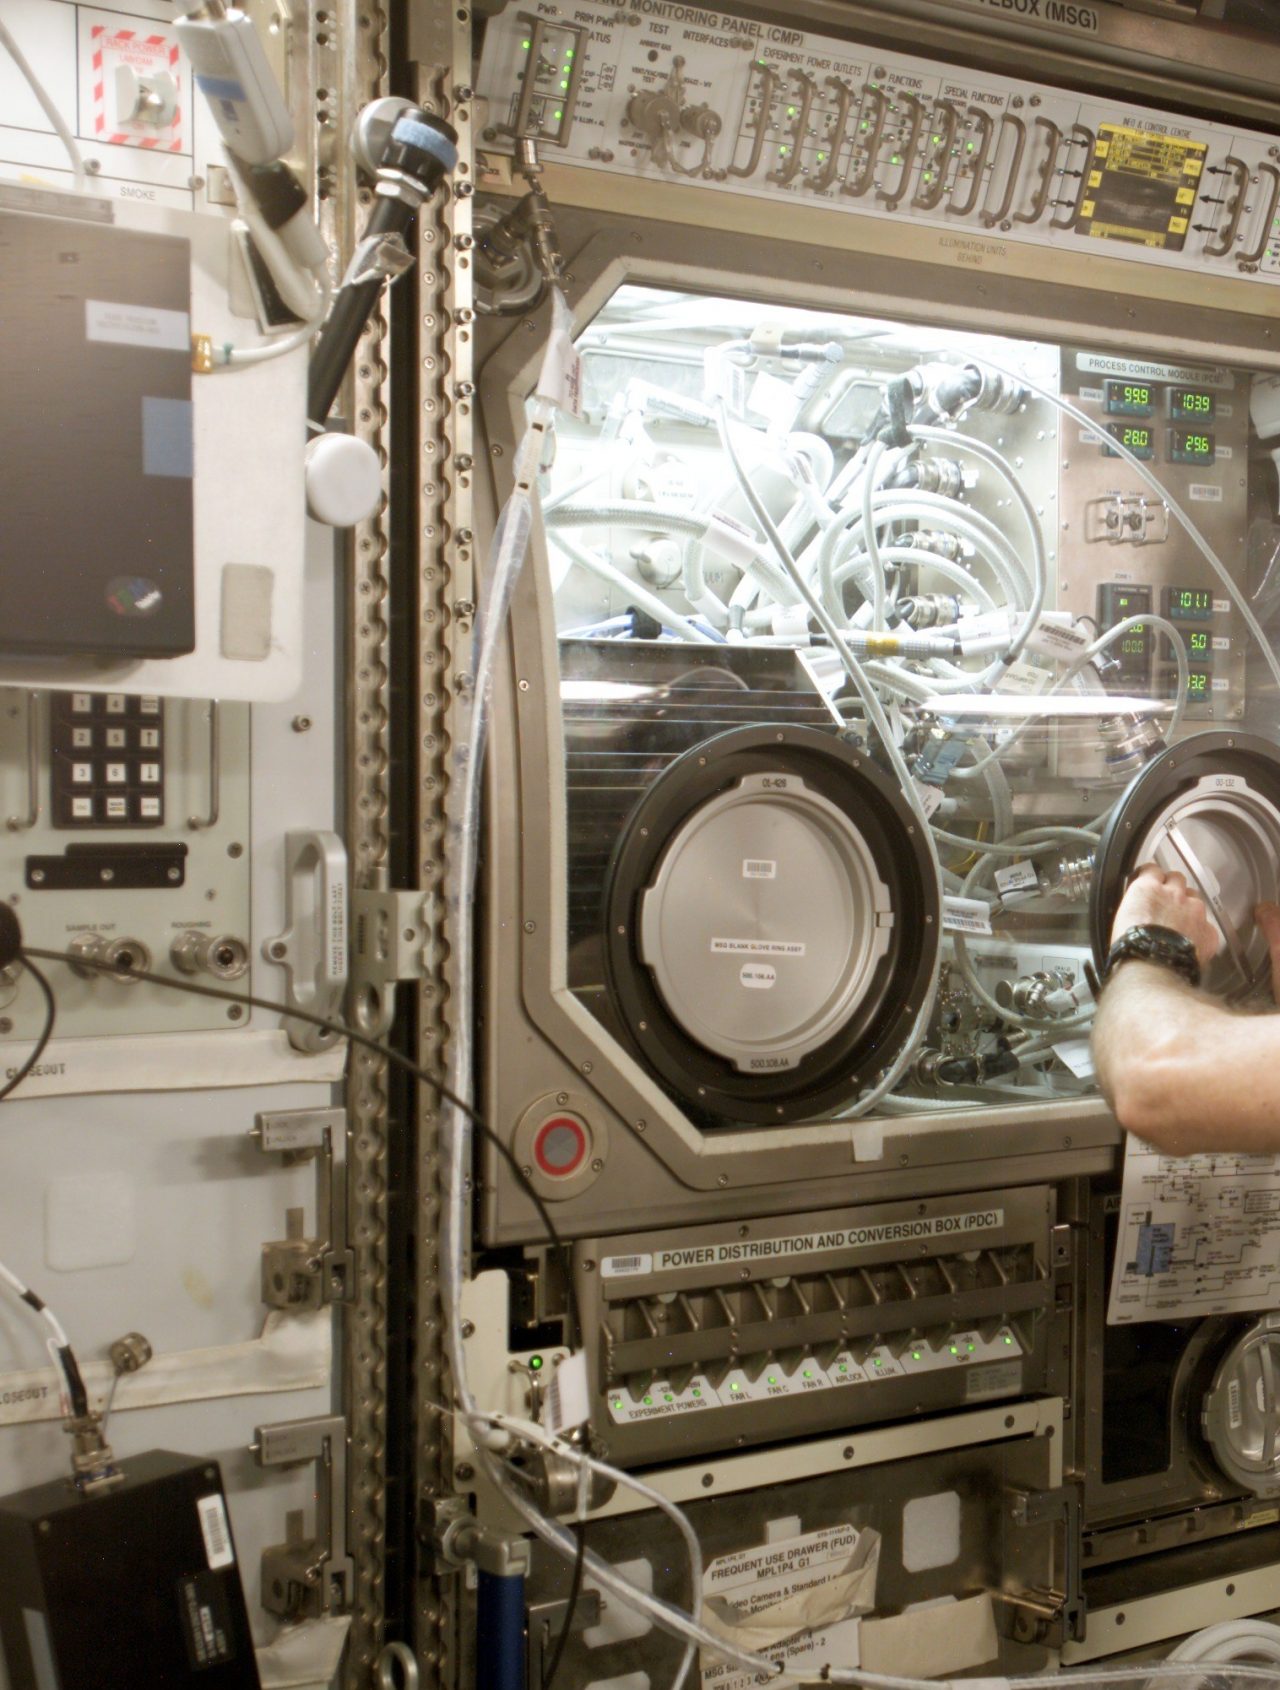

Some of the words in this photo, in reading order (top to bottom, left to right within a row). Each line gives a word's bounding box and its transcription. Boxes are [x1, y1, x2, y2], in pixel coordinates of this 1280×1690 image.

[537, 3, 558, 15] PWR
[982, 0, 1040, 16] BOX
[1045, 1, 1098, 31] (MSG)
[629, 0, 719, 28] MONITORING
[720, 14, 765, 39] PANEL
[766, 26, 804, 46] (CMP)
[648, 22, 670, 35] TEST
[682, 30, 729, 48] INTERFACES
[763, 47, 805, 64] EXPERIMENT
[806, 56, 832, 70] POWER
[833, 62, 863, 76] OUTLETS
[888, 74, 924, 88] FUNCTIONS
[944, 86, 969, 100] SPECIAL
[970, 90, 1005, 106] FUNCTIONS
[119, 185, 156, 201] SMOKE
[1089, 358, 1127, 372] PROCESS
[1128, 364, 1166, 377] CONTROL
[1167, 369, 1199, 381] MODULE
[79, 767, 86, 776] 3
[111, 768, 119, 777] 6
[65, 924, 98, 932] SAMPLE
[99, 923, 116, 931] OUT
[171, 921, 212, 929] ROUGHING
[661, 1248, 715, 1268] POWER
[718, 1236, 814, 1261] DISTRIBUTION
[816, 1233, 845, 1249] AND
[847, 1221, 932, 1245] CONVERSION
[935, 1216, 961, 1233] BOX
[963, 1212, 998, 1230] (PDC)
[802, 1380, 818, 1390] FAN
[818, 1379, 824, 1388] R
[835, 1373, 863, 1384] AIRLOCK
[729, 1392, 745, 1402] FAN
[746, 1391, 752, 1399] L
[767, 1386, 783, 1396] FAN
[783, 1385, 789, 1394] C
[628, 1404, 677, 1419] EXPERIMENT
[677, 1398, 707, 1412] POWERS
[711, 1558, 763, 1581] FREQUENT
[765, 1551, 785, 1564] USE
[787, 1542, 828, 1560] DRAWER
[830, 1534, 857, 1551] (FUD)
[750, 1589, 782, 1605] Camera
[783, 1586, 790, 1595] &
[791, 1575, 827, 1594] Standard
[787, 1640, 815, 1659] (Spare)
[821, 1636, 827, 1647] 2
[704, 1665, 725, 1681] MSG
